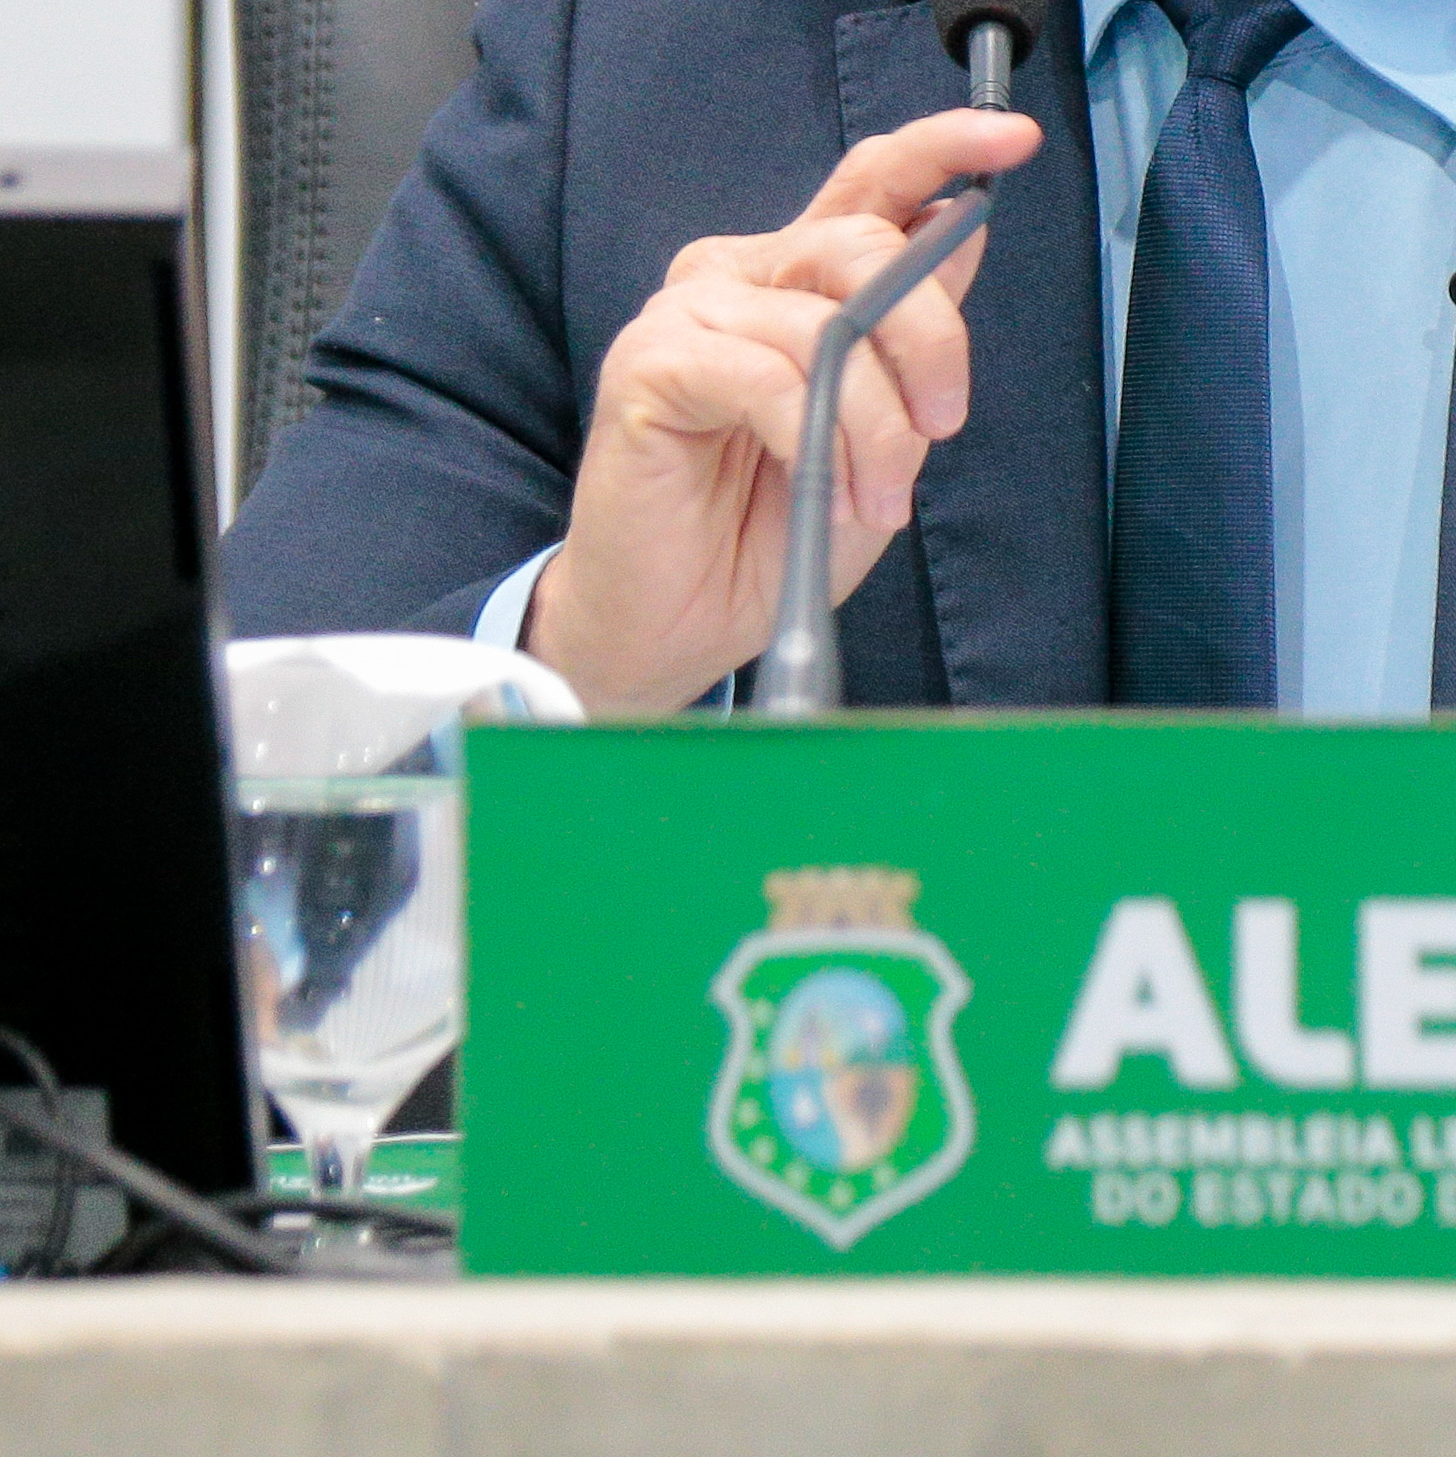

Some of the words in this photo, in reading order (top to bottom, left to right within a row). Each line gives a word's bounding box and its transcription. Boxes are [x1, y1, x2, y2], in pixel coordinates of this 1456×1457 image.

[1046, 1115, 1401, 1169] ASSEMBLEIA
[1092, 1172, 1182, 1226] DO
[1194, 1172, 1423, 1226] ESTADO
